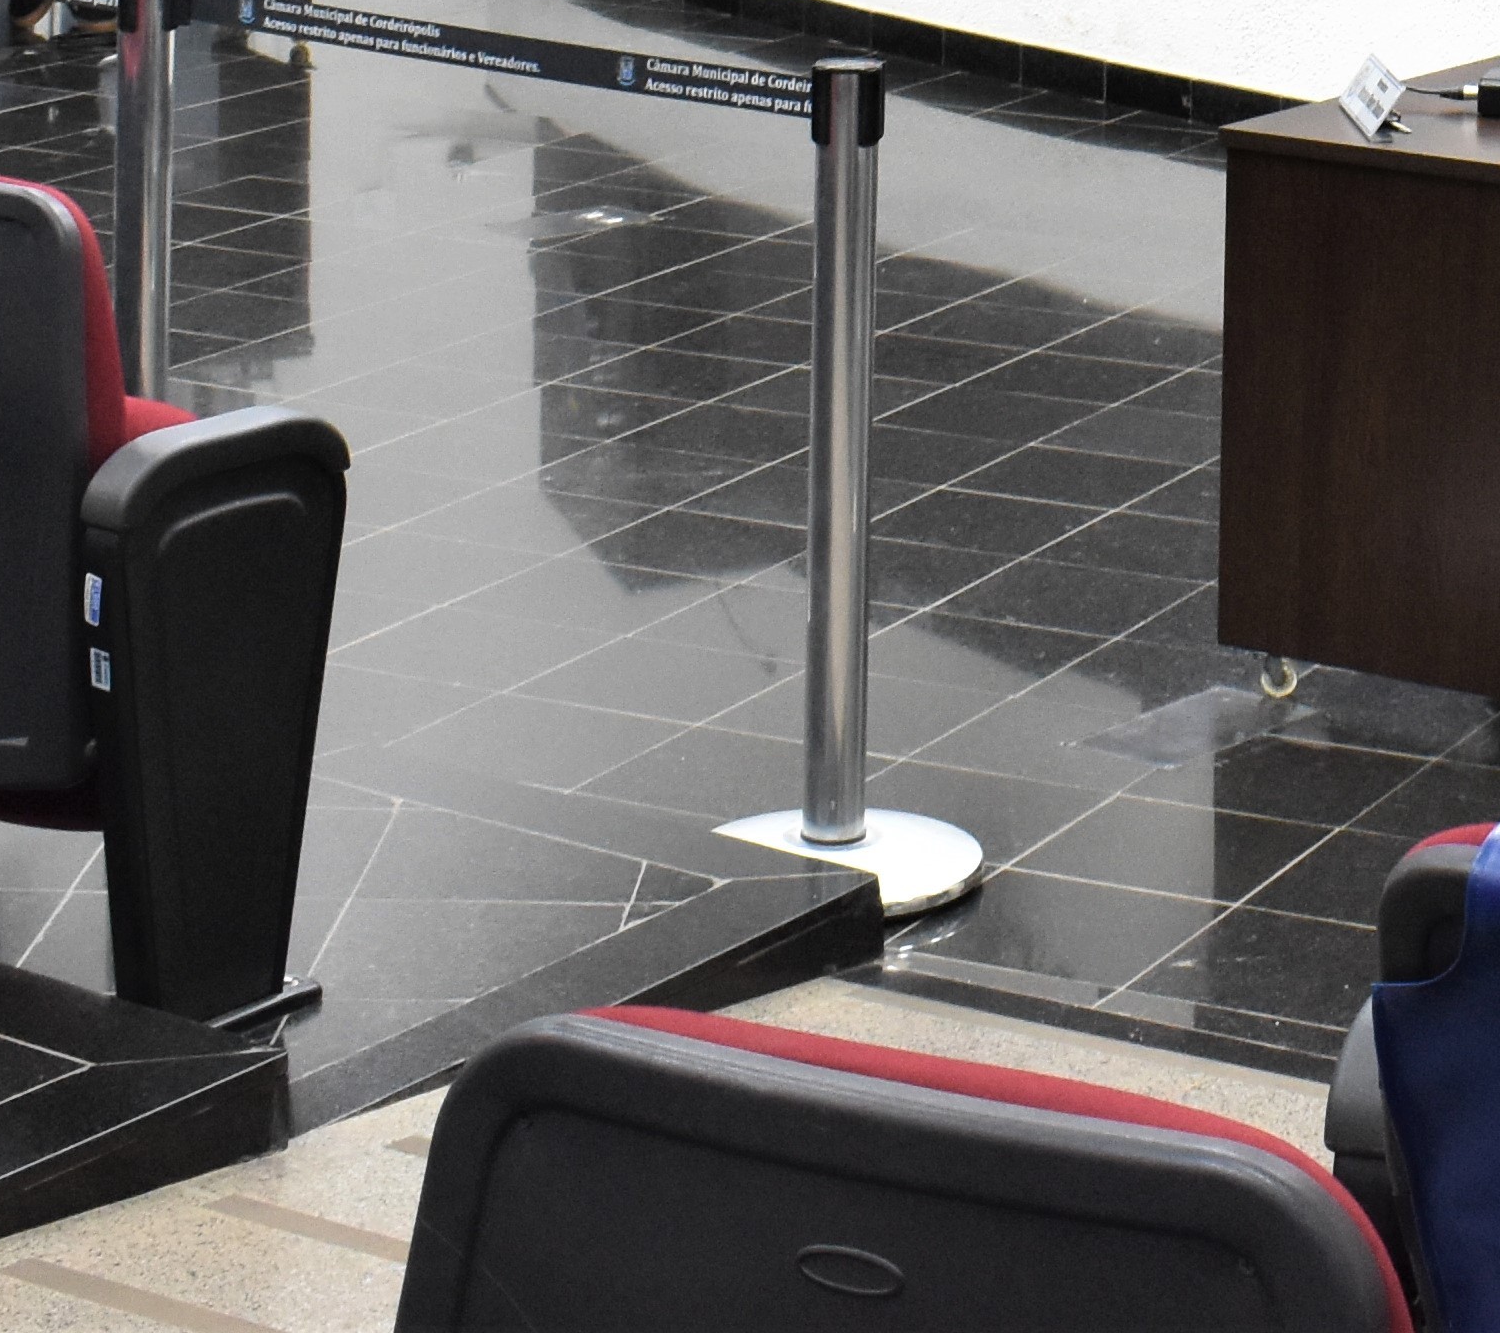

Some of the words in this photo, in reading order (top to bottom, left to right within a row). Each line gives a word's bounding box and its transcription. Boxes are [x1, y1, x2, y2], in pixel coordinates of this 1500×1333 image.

[303, 4, 353, 25] Municipal
[355, 13, 368, 27] de
[369, 15, 441, 38] Cordeirópolis
[263, 16, 297, 33] Acesso
[299, 23, 337, 39] restrito
[338, 31, 375, 46] apenas
[375, 36, 399, 50] para
[401, 39, 468, 62] funcionários
[468, 52, 476, 63] e
[646, 58, 690, 76] Câmara
[692, 64, 749, 85] Municipal
[751, 71, 766, 87] de
[767, 76, 813, 93] Cordeir
[644, 77, 683, 95] Acesso
[685, 84, 729, 101] restrito
[730, 91, 772, 107] apenas
[774, 98, 801, 113] para
